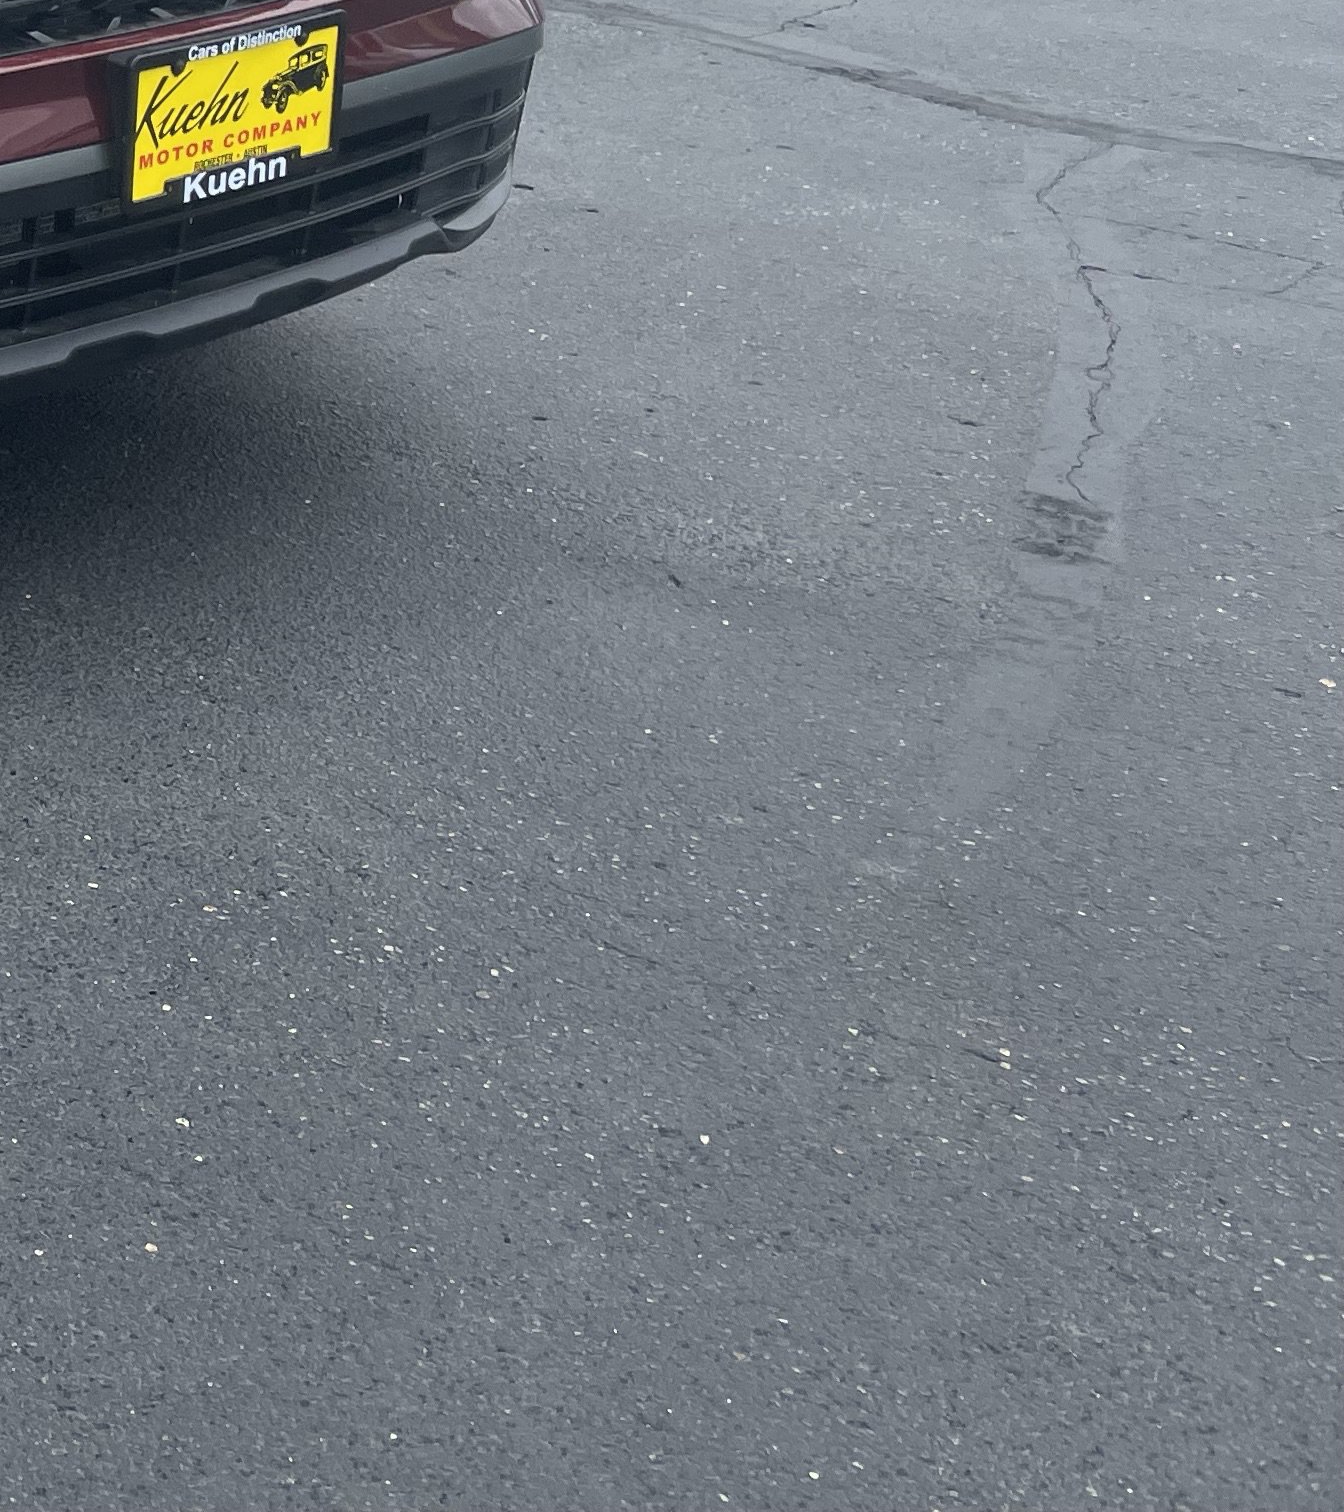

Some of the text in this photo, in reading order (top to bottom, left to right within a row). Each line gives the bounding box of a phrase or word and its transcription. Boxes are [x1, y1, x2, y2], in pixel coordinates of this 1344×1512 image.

[188, 24, 302, 61] Cars of Distinction
[134, 60, 250, 150] Kuehn
[139, 110, 322, 170] MOTOR COMPANY
[182, 155, 287, 204] Kuehn
